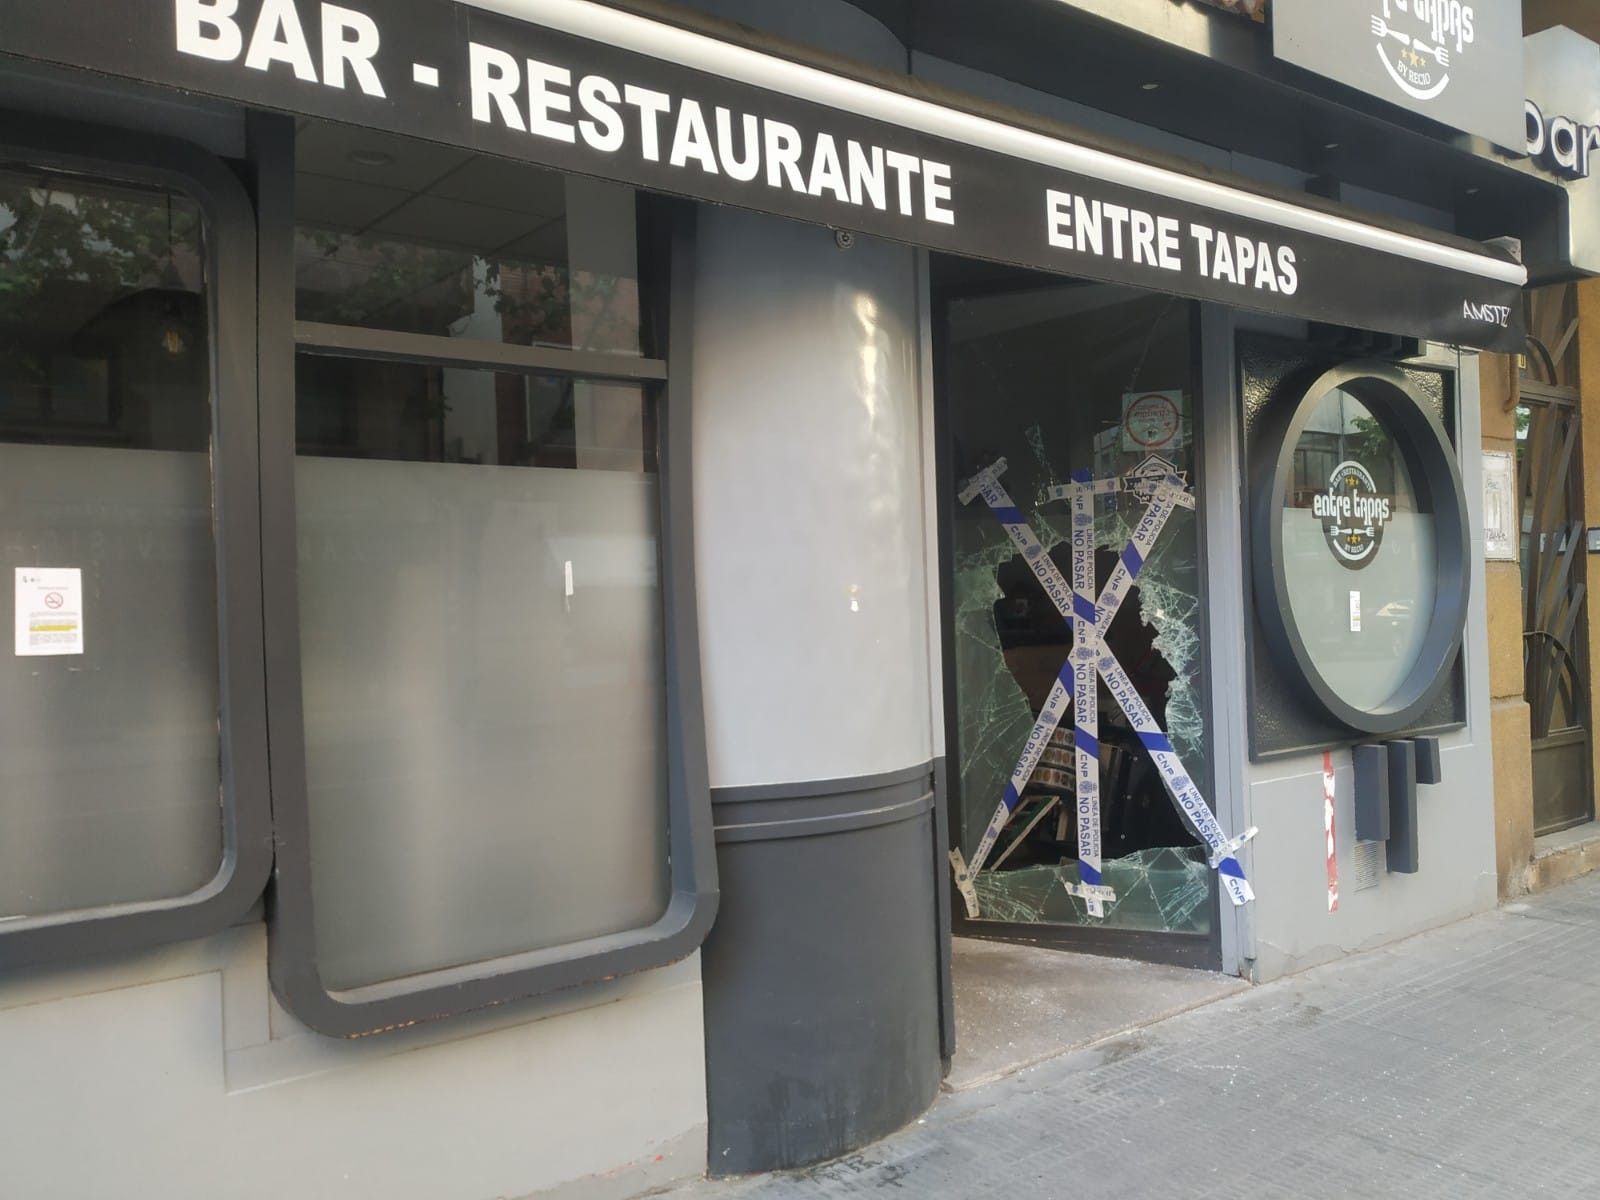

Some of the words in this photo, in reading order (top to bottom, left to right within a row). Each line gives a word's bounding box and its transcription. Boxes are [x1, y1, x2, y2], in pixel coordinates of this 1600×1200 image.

[1397, 60, 1408, 77] BY
[1408, 69, 1431, 86] RECIO
[175, 0, 387, 98] BAR
[468, 41, 955, 226] RESTAURANTE
[1046, 188, 1182, 271] ENTRE
[1190, 223, 1299, 296] TAPAS
[1313, 487, 1351, 525] entre
[1135, 503, 1161, 541] PASAR
[1010, 525, 1028, 546] CNP
[1074, 529, 1085, 547] NO
[1074, 550, 1085, 589] PASAR
[1111, 568, 1126, 591] CNP
[1032, 560, 1047, 577] NO
[1043, 576, 1070, 614] PASAR
[1078, 620, 1086, 644] CNP
[1076, 663, 1087, 680] NO
[1050, 687, 1063, 709] CNP
[1076, 683, 1088, 723] PASAR
[1105, 672, 1120, 690] NO
[1116, 690, 1144, 728] PASAR
[1031, 723, 1045, 740] NO
[1080, 754, 1089, 778] CNP
[1156, 752, 1175, 776] CNP
[1079, 797, 1090, 814] NO
[1178, 792, 1195, 810] NO
[1190, 810, 1221, 848] PASAR
[1080, 817, 1092, 857] PASAR
[1229, 879, 1246, 903] CNP
